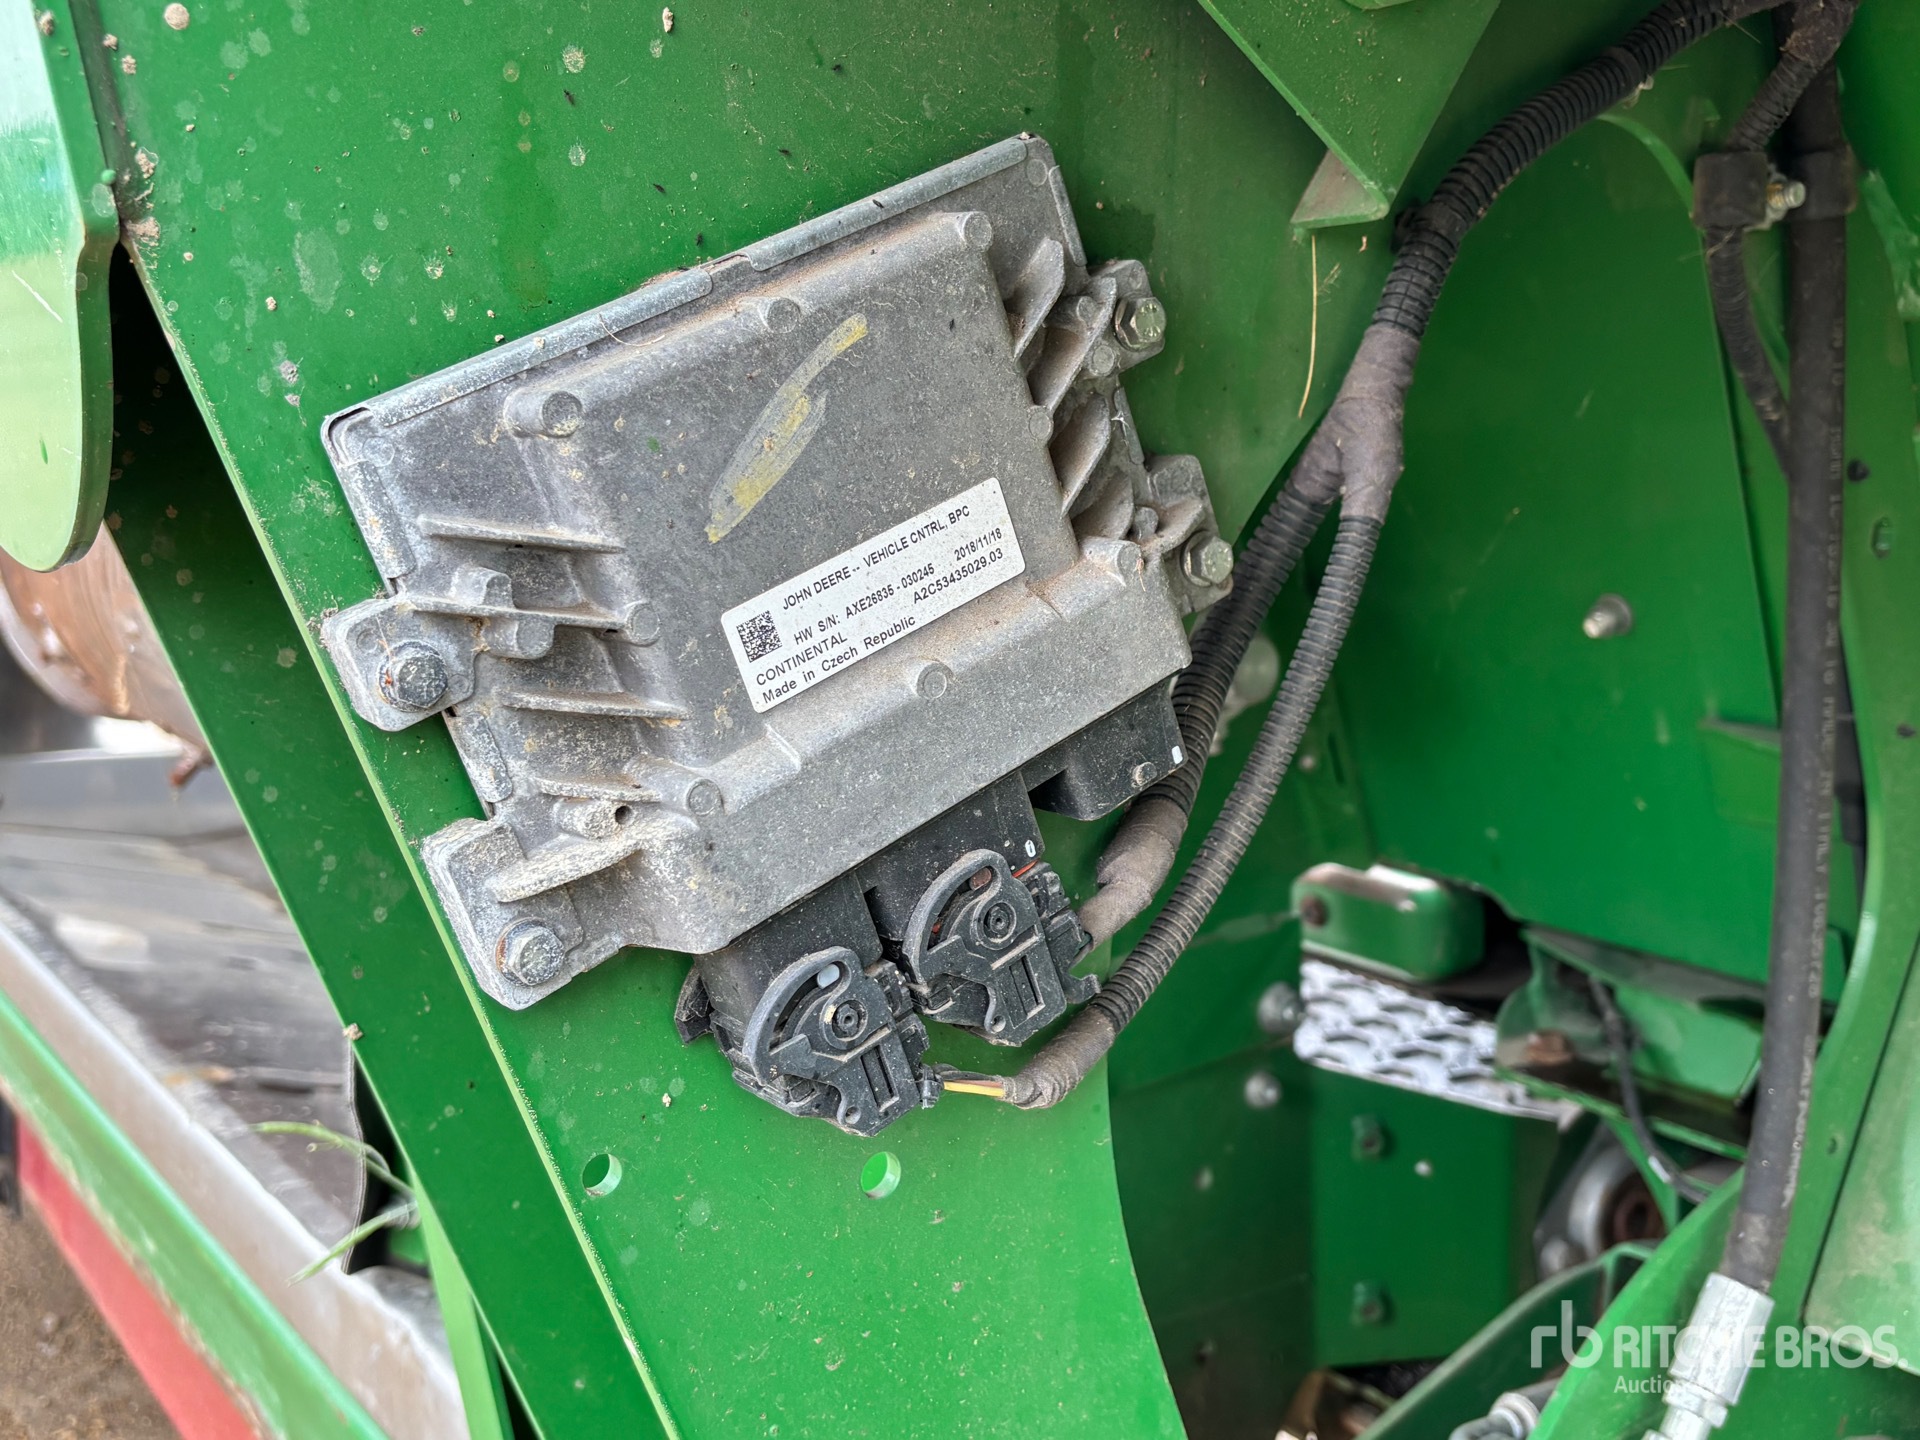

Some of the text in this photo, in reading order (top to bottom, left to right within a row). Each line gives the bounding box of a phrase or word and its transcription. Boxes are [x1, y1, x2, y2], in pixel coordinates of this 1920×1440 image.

[783, 586, 812, 610] JOHN
[813, 566, 851, 594] DEERE
[863, 536, 909, 568] VEHICLE
[910, 519, 948, 544] CNTRL,
[948, 505, 970, 525] BPC
[794, 626, 813, 645] HW
[818, 614, 841, 632] S/N:
[845, 584, 895, 619] AXE26835
[901, 563, 935, 589] 030245
[954, 527, 1002, 561] 2018/11/18
[756, 547, 1003, 686] CONTINENTAL A2C53435029.03
[762, 616, 916, 704] Made in Czech Republic
